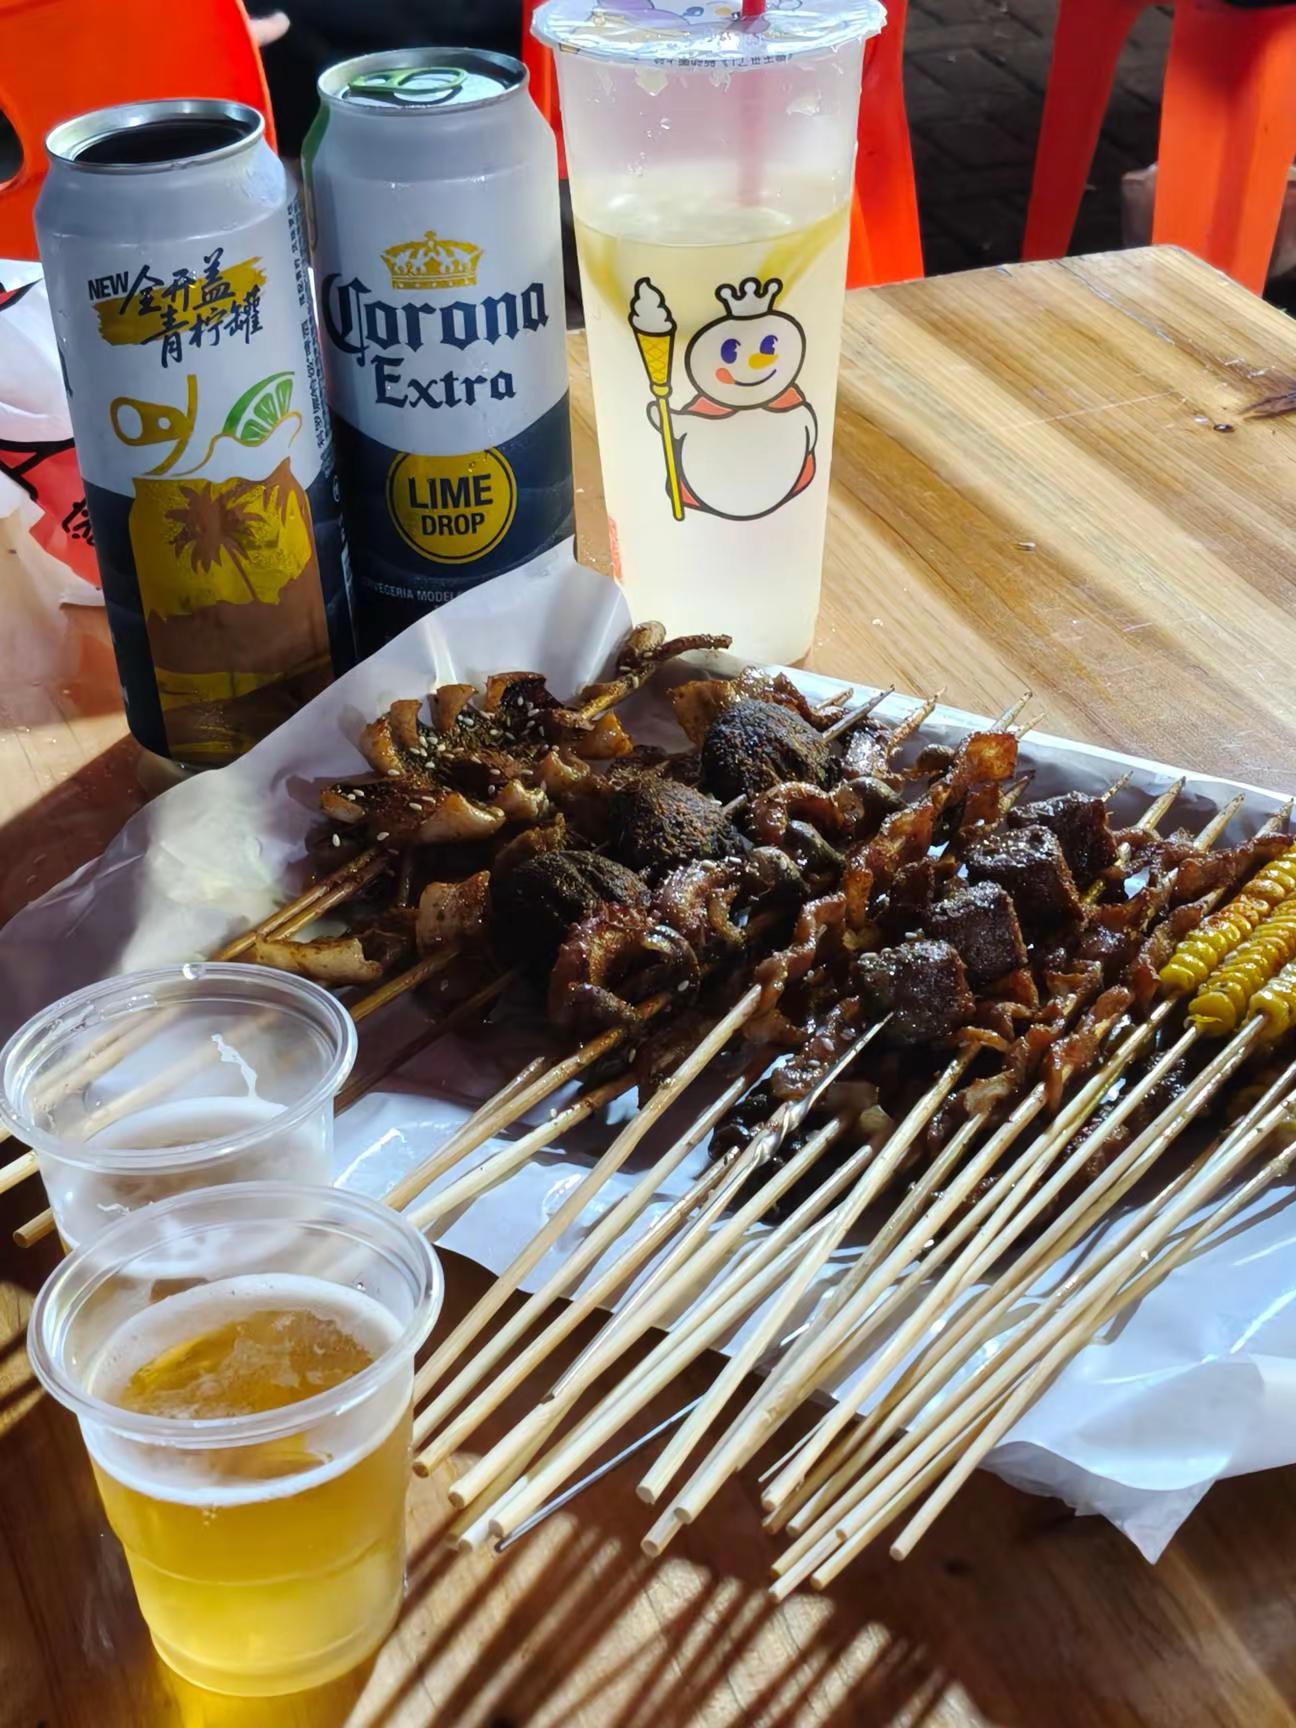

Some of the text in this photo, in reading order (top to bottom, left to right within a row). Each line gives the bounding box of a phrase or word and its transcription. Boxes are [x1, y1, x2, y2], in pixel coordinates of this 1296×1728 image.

[88, 271, 129, 300] NEW
[119, 247, 236, 316] 全开盖
[140, 284, 263, 368] 青柠罐
[322, 273, 549, 367] Corona
[371, 354, 516, 409] Extra
[408, 473, 494, 509] LIME
[421, 512, 485, 536] DROP
[416, 589, 459, 603] MODEL
